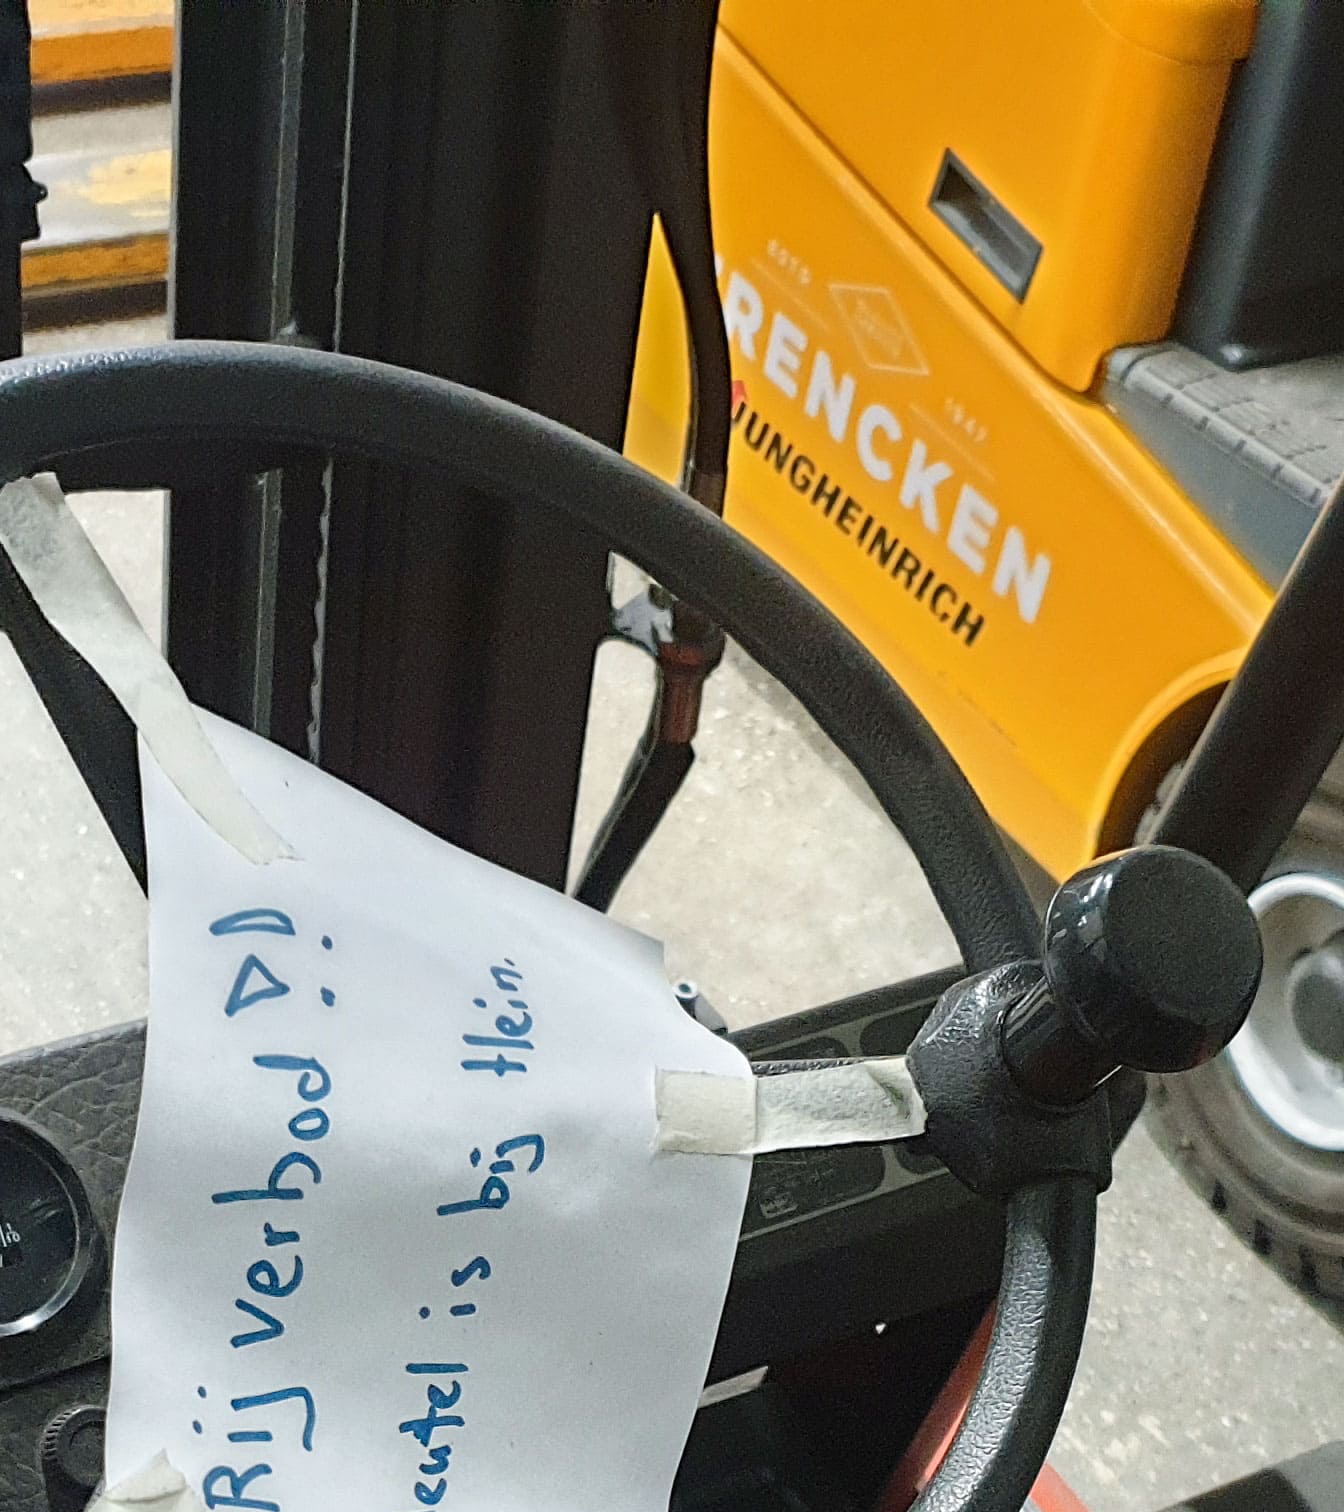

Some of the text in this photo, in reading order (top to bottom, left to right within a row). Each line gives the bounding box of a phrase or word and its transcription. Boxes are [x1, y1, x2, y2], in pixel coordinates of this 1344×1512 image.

[715, 253, 1052, 624] RENCKEN
[731, 400, 987, 648] JUNGHEINRICH
[436, 1134, 546, 1218] bij
[418, 1256, 492, 1320] is
